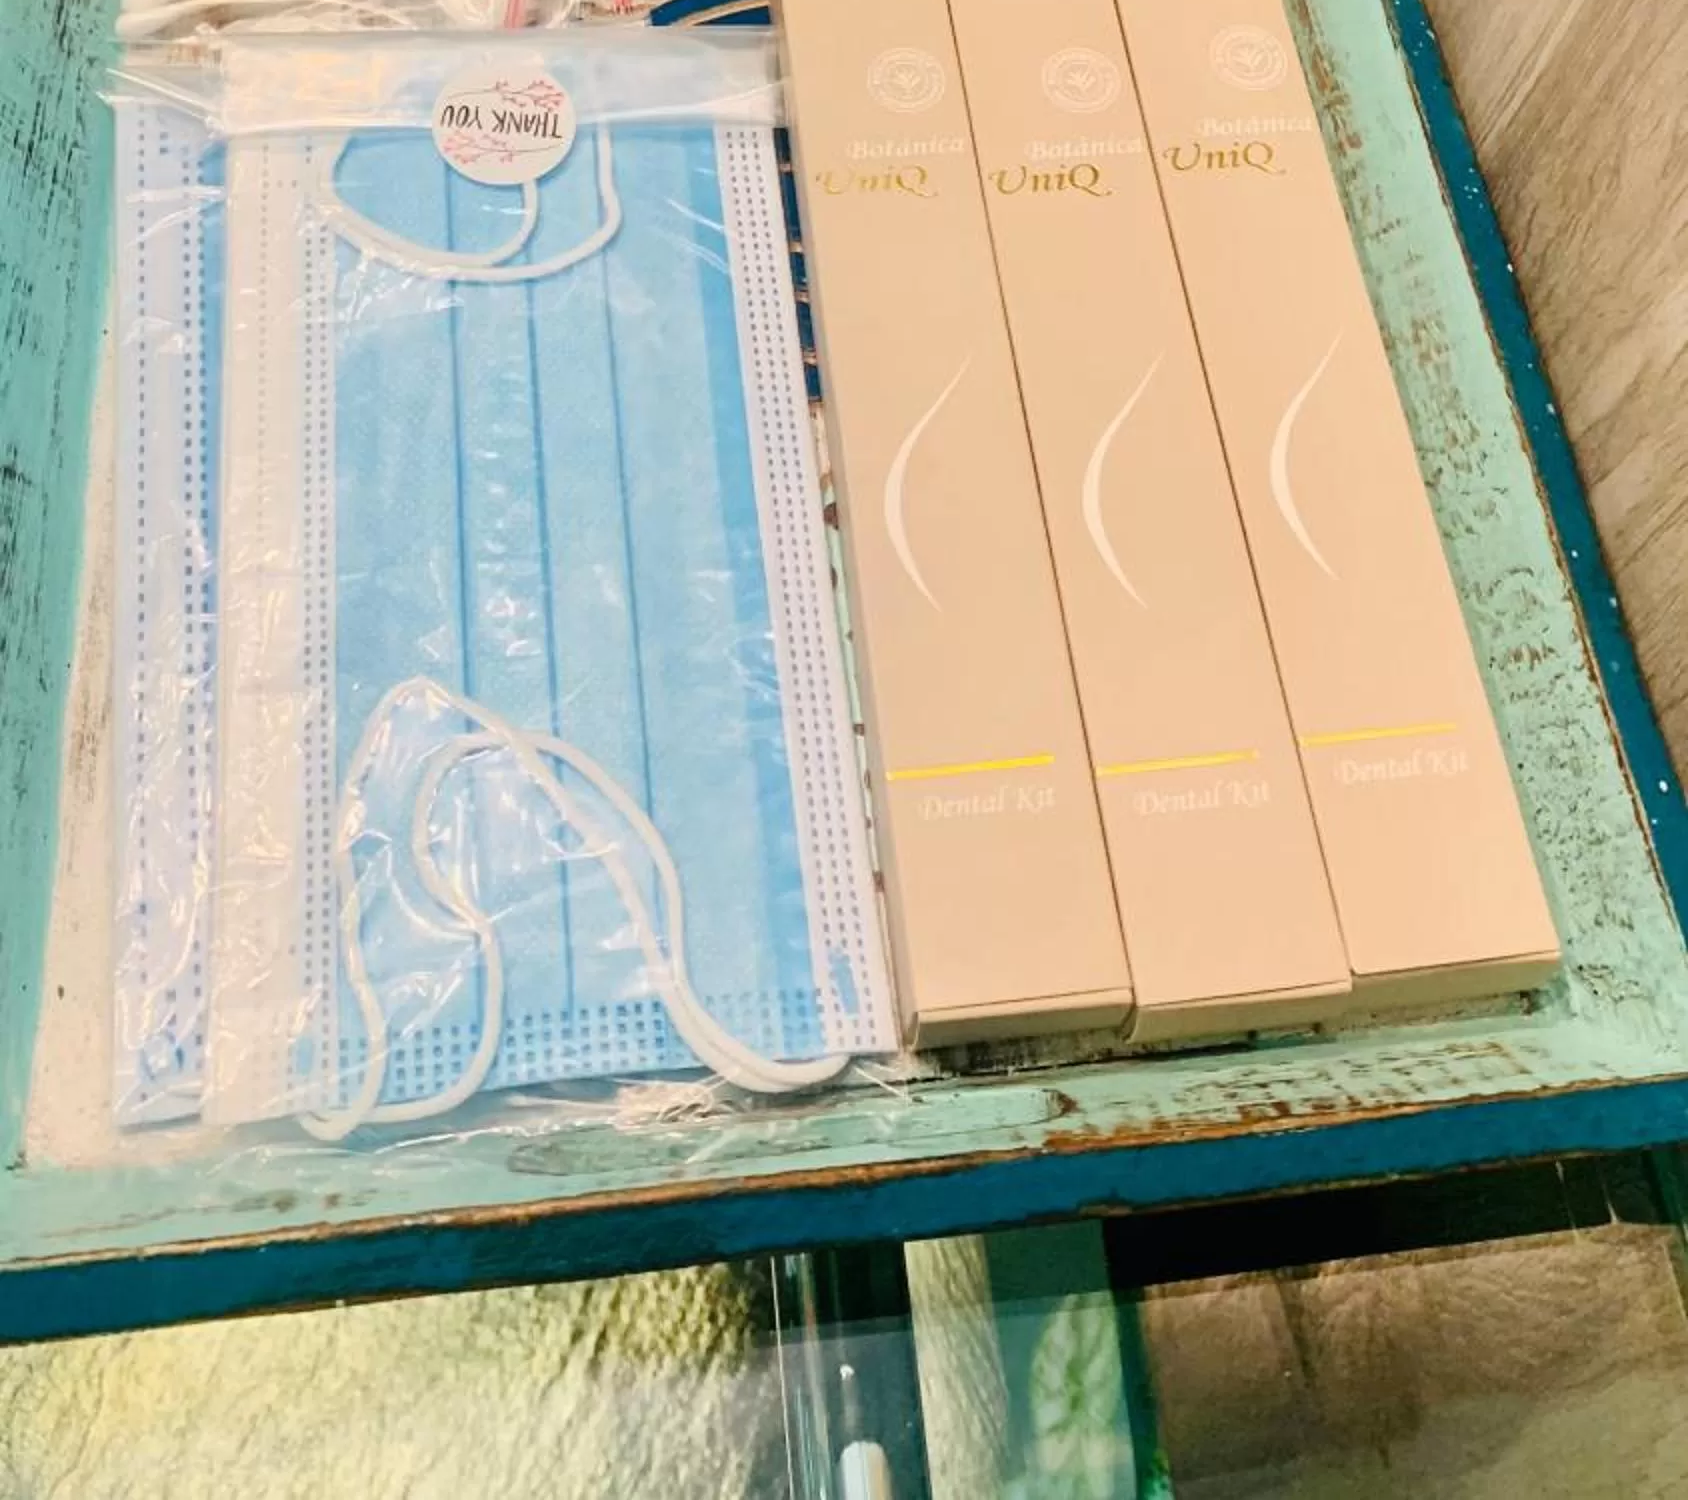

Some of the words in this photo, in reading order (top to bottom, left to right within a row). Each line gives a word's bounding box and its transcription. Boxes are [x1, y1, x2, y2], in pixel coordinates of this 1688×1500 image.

[440, 104, 482, 131] YOU
[492, 109, 563, 140] THANK
[1162, 140, 1287, 175] UniQ
[815, 164, 939, 199] UniQ
[988, 163, 1113, 198] UniQ
[1332, 748, 1422, 785] Dental
[917, 784, 1008, 821] Dental
[1131, 778, 1224, 816] Dental
